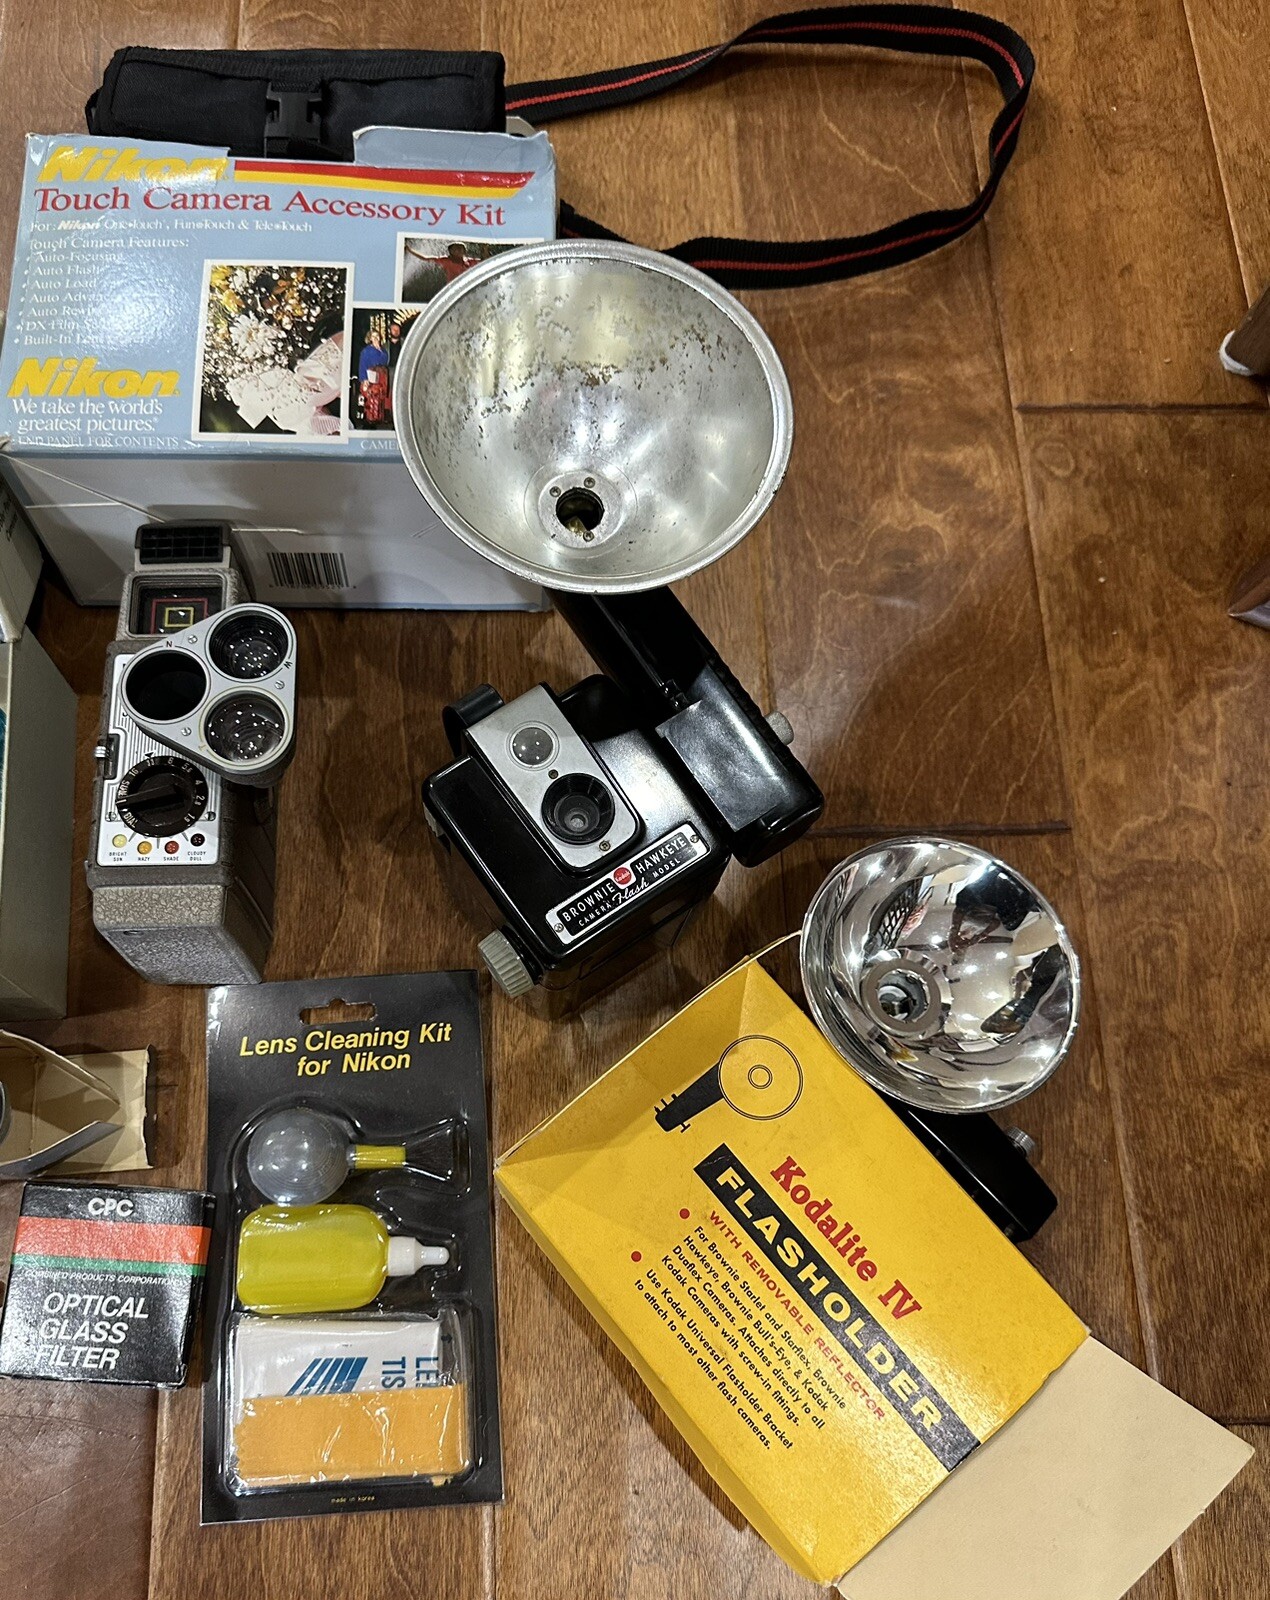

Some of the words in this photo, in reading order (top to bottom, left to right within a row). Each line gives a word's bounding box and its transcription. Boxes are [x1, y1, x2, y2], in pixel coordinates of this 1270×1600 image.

[34, 187, 131, 212] Touch
[143, 187, 272, 212] Camera
[283, 191, 446, 226] Accessory
[457, 204, 507, 226] Kit
[238, 219, 249, 230] &
[71, 238, 124, 249] Camera
[129, 237, 190, 248] Features:
[31, 280, 62, 290] Auto
[65, 279, 98, 289] Load
[32, 266, 63, 276] Auto
[30, 293, 60, 303] Auto
[27, 307, 58, 317] Auto
[6, 356, 181, 398] Nikon
[13, 399, 38, 415] We
[42, 399, 76, 415] take
[80, 399, 106, 415] the
[109, 399, 163, 415] world's
[17, 416, 81, 434] greatest
[115, 436, 179, 447] CONTENTS
[166, 640, 173, 648] N
[123, 811, 139, 829] DIAL
[562, 882, 615, 923] BROWNIE
[635, 836, 687, 874] HAWKEYE
[578, 902, 612, 928] CAMERA
[611, 877, 650, 905] Flash
[651, 859, 681, 879] MODEL
[239, 1035, 298, 1057] Lens
[304, 1026, 410, 1052] Cleaning
[419, 1022, 453, 1044] Kit
[297, 1055, 332, 1077] for
[341, 1051, 411, 1074] Nikon
[87, 1197, 134, 1217] CPC
[769, 1155, 878, 1282] Kodalite
[878, 1279, 923, 1320] IV
[69, 1272, 116, 1282] PRODUCTS
[42, 1291, 149, 1320] OPTICAL
[716, 1166, 943, 1433] FLASHOLDER
[683, 1235, 720, 1283] Hawkeye,
[721, 1280, 754, 1321] Brownie
[753, 1319, 792, 1370] Bull's-Eye,
[793, 1368, 803, 1380] &
[801, 1377, 829, 1412] Kodak
[693, 1225, 709, 1243] For
[708, 1242, 740, 1281] Brownie
[739, 1280, 766, 1311] Starlet
[764, 1311, 783, 1331] and
[781, 1330, 812, 1370] Starflex,
[813, 1368, 847, 1410] Brownie
[709, 1209, 743, 1250] WITH
[741, 1250, 815, 1336] REMOVABLE
[813, 1336, 886, 1421] REFLECTOR
[38, 1318, 129, 1344] GLASS
[661, 1254, 688, 1287] Kodak
[687, 1286, 721, 1328] Cameras
[720, 1327, 740, 1350] with
[738, 1350, 772, 1391] screw-in
[771, 1389, 800, 1427] fittings.
[672, 1244, 703, 1283] Duaflex
[702, 1281, 736, 1326] Cameras.
[738, 1326, 773, 1368] Attaches
[772, 1367, 803, 1403] directly
[801, 1402, 811, 1414] to
[811, 1415, 826, 1430] all
[35, 1344, 120, 1370] FILTER
[634, 1279, 644, 1291] to
[644, 1291, 668, 1321] attach
[667, 1320, 677, 1332] to
[676, 1332, 698, 1357] most
[696, 1357, 718, 1382] other
[717, 1381, 738, 1407] flash
[737, 1406, 771, 1450] cameras.
[646, 1268, 662, 1289] Use
[661, 1287, 687, 1321] Kodak
[686, 1319, 725, 1365] Universal
[722, 1363, 764, 1414] Flasholder
[762, 1412, 794, 1450] Bracket
[415, 1356, 439, 1388] LE
